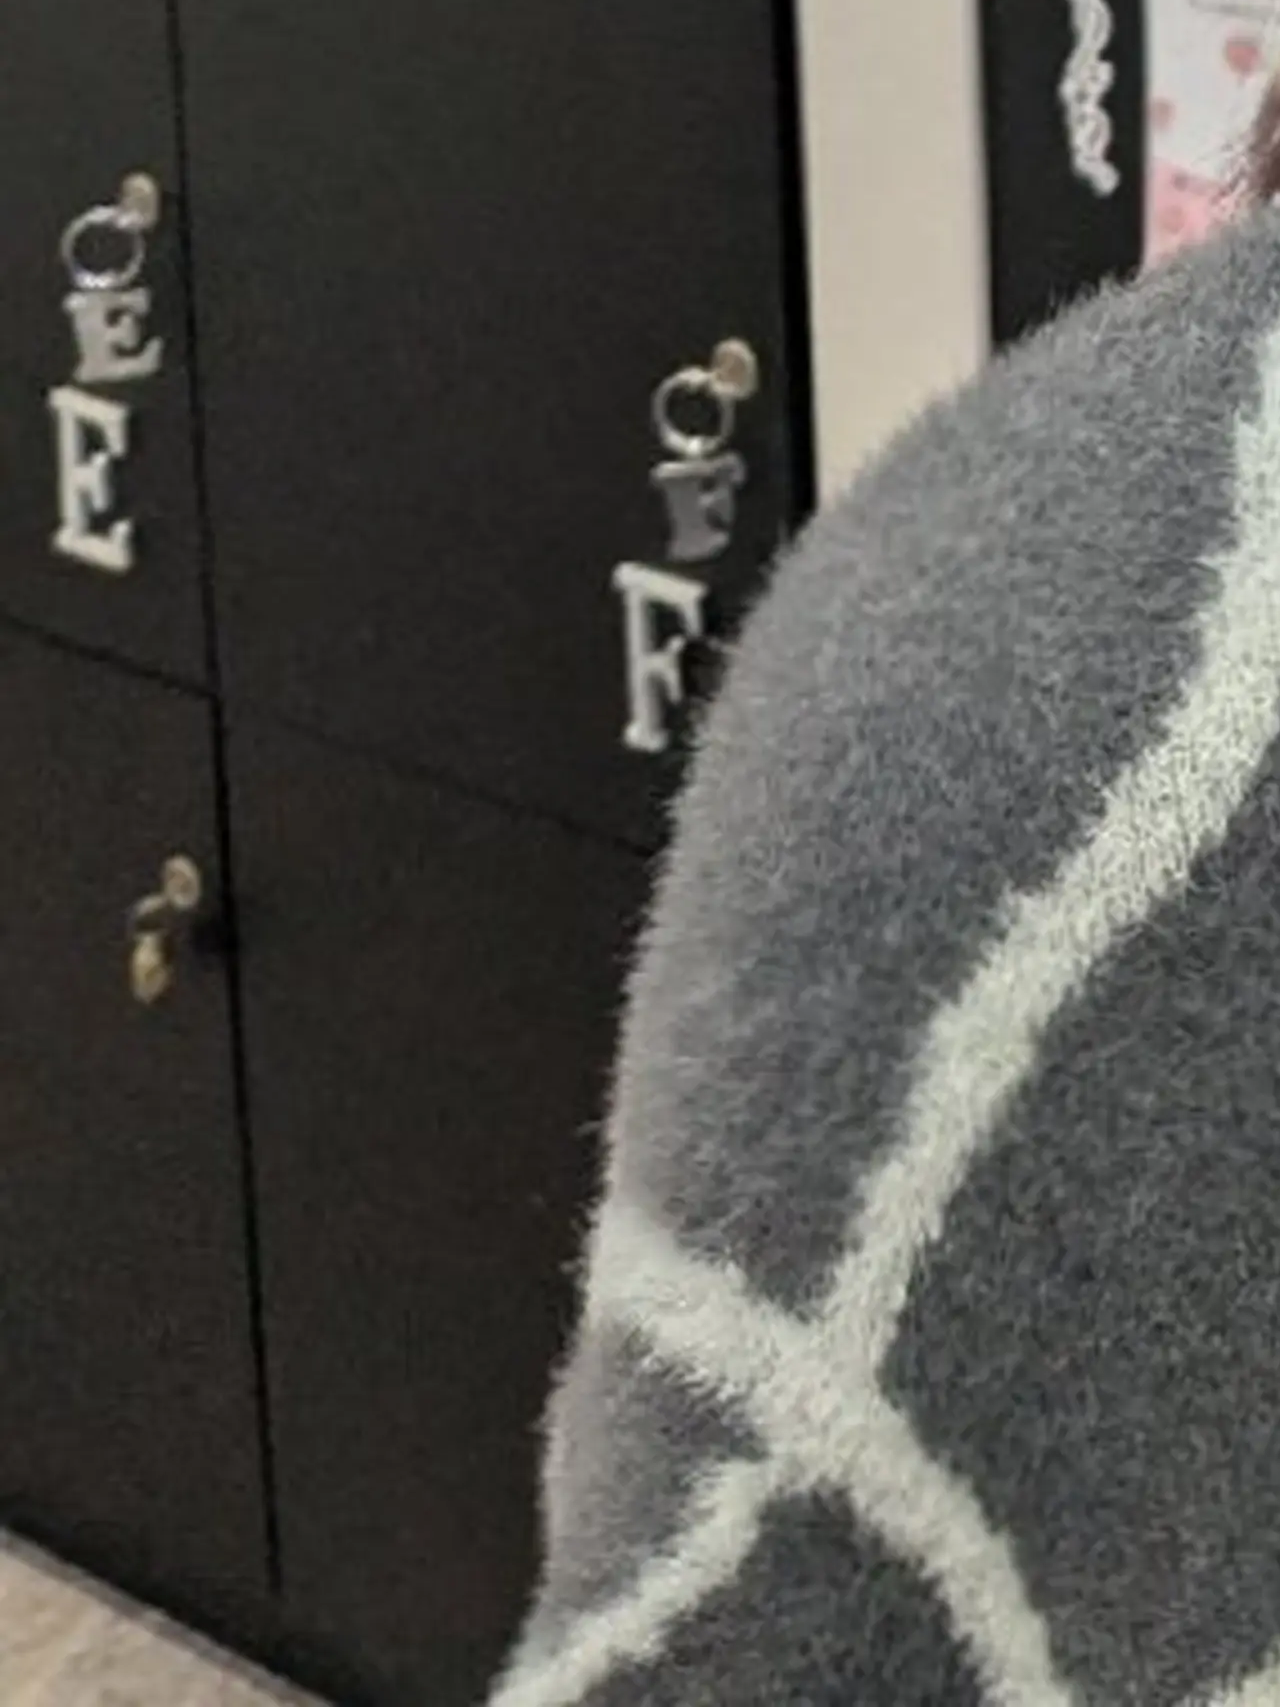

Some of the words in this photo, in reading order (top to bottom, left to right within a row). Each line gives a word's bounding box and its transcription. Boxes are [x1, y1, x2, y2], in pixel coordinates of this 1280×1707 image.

[62, 287, 163, 384] E
[48, 387, 134, 575] E
[611, 561, 708, 753] F
